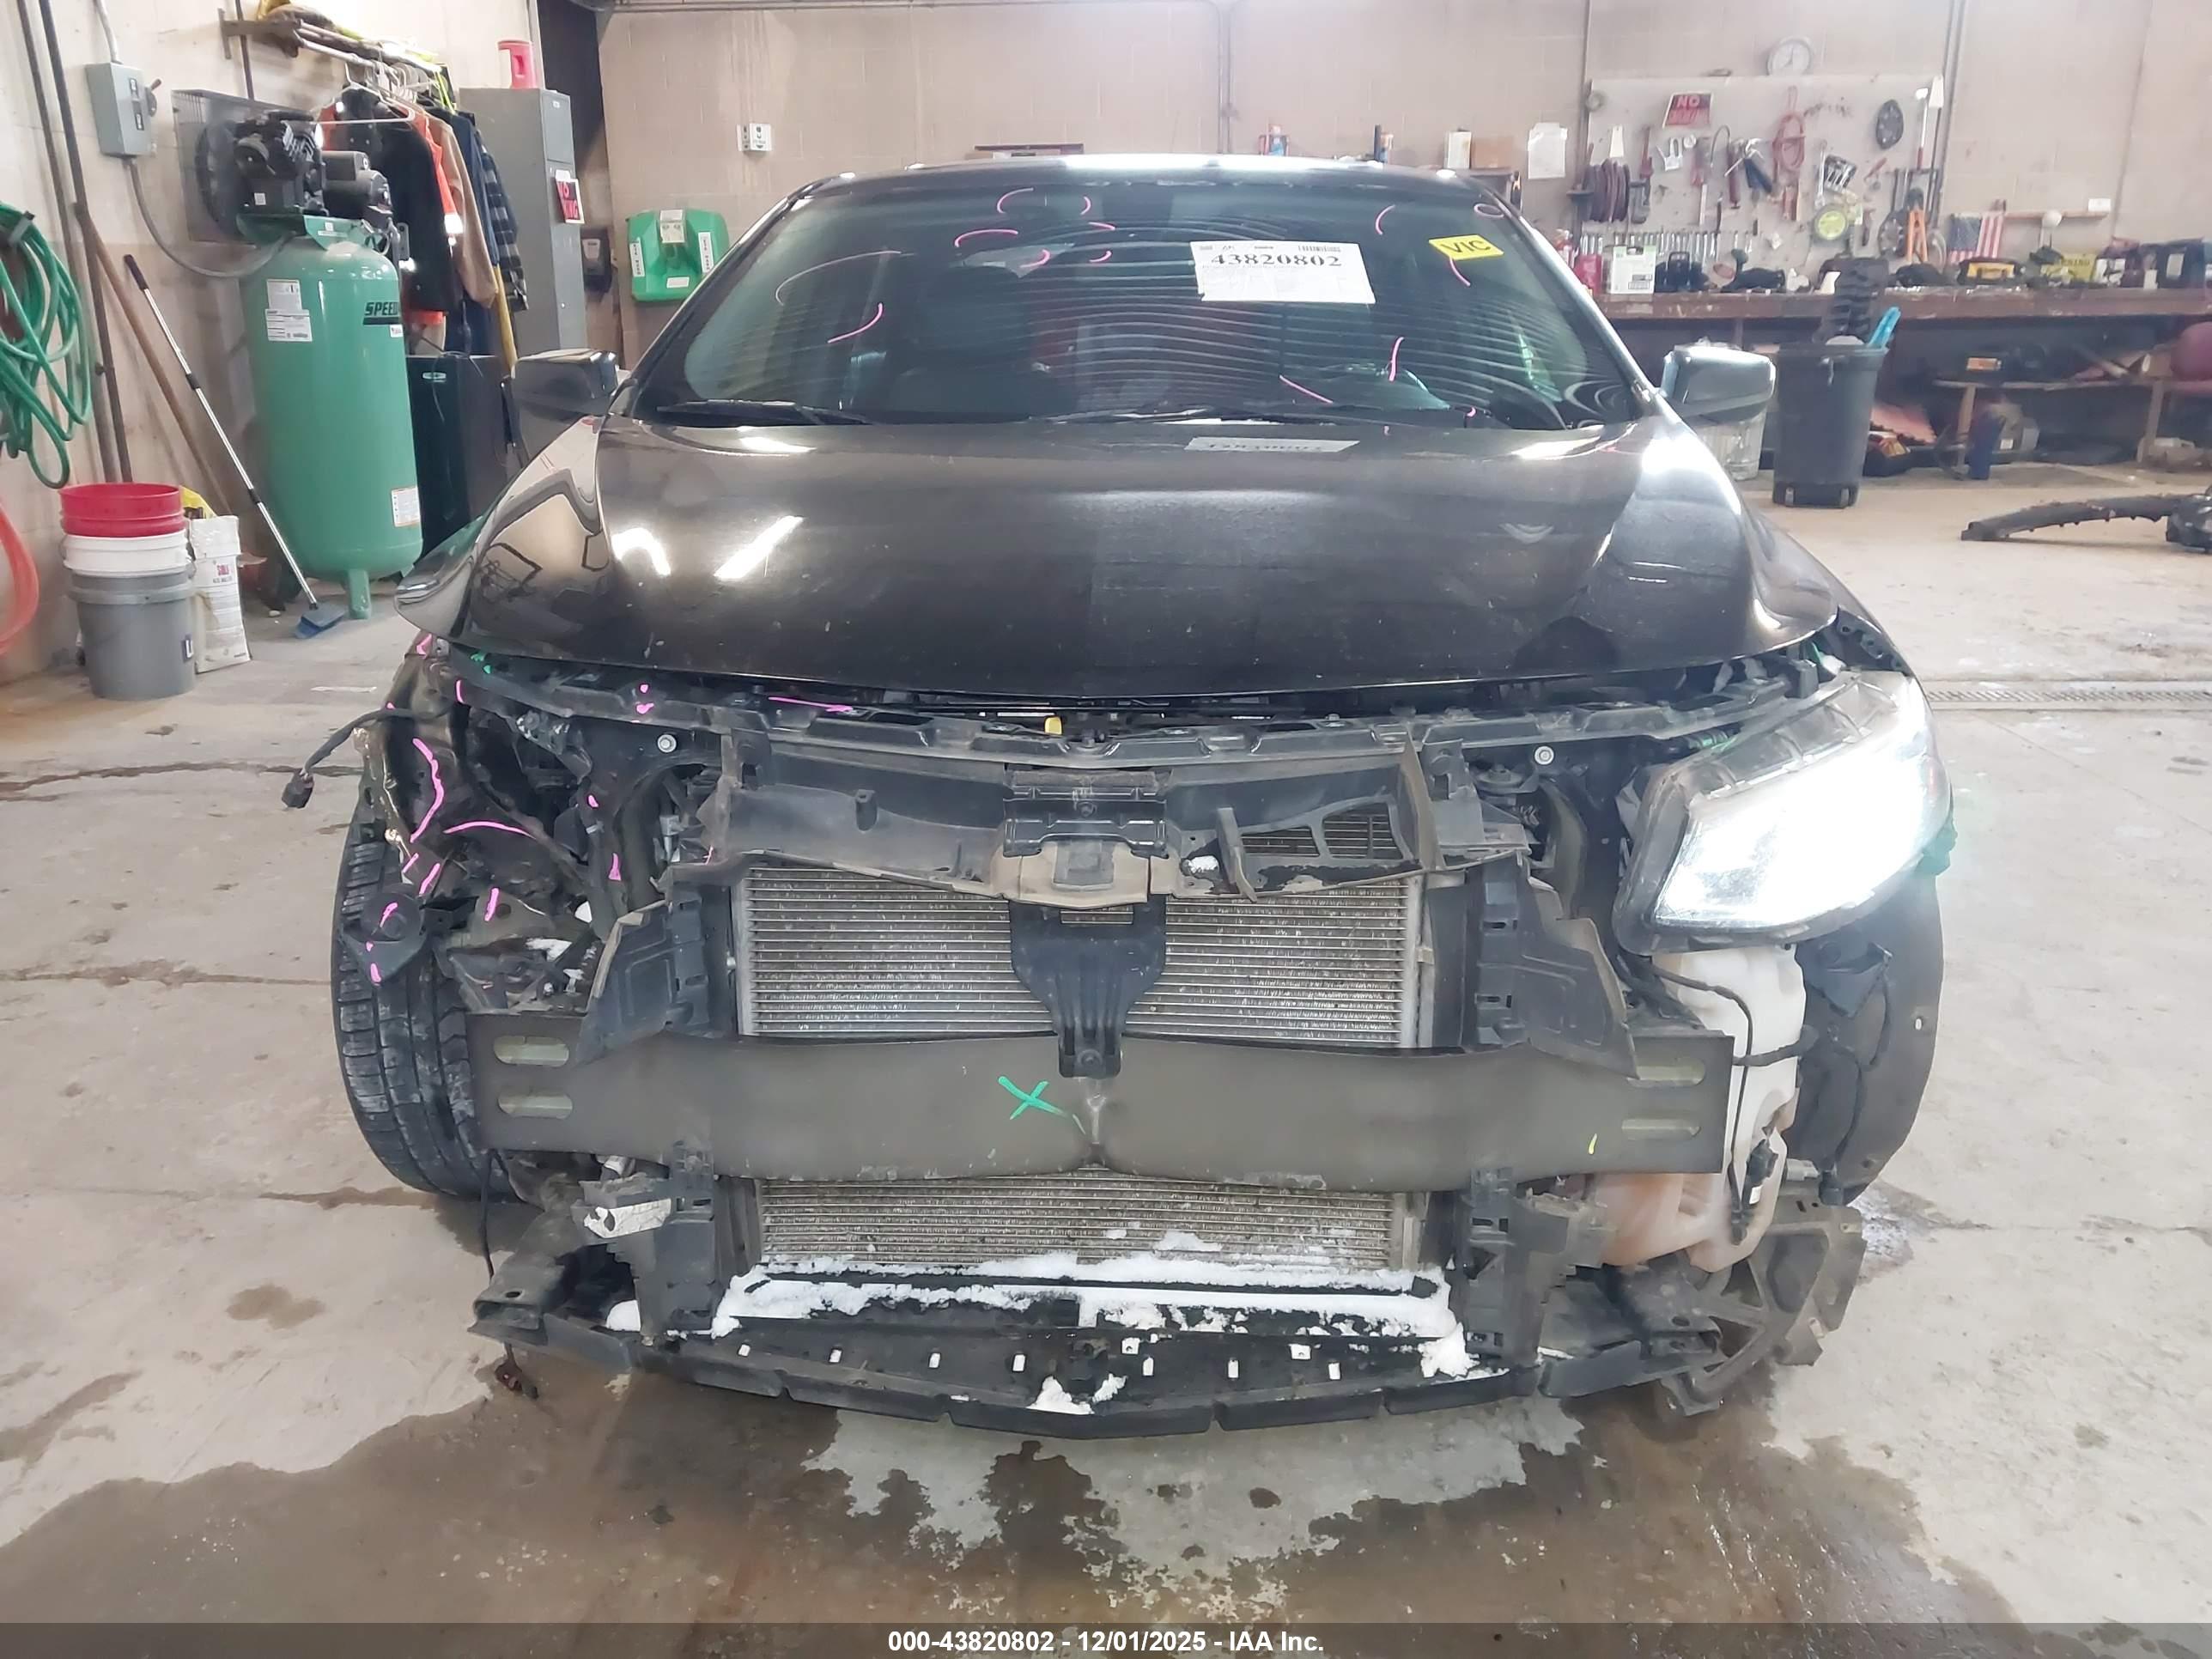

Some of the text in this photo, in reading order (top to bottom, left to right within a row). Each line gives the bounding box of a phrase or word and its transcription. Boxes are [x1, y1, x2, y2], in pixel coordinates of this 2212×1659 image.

[1676, 95, 1700, 107] NO
[1439, 240, 1492, 252] VIC
[1212, 254, 1341, 267] 43820802
